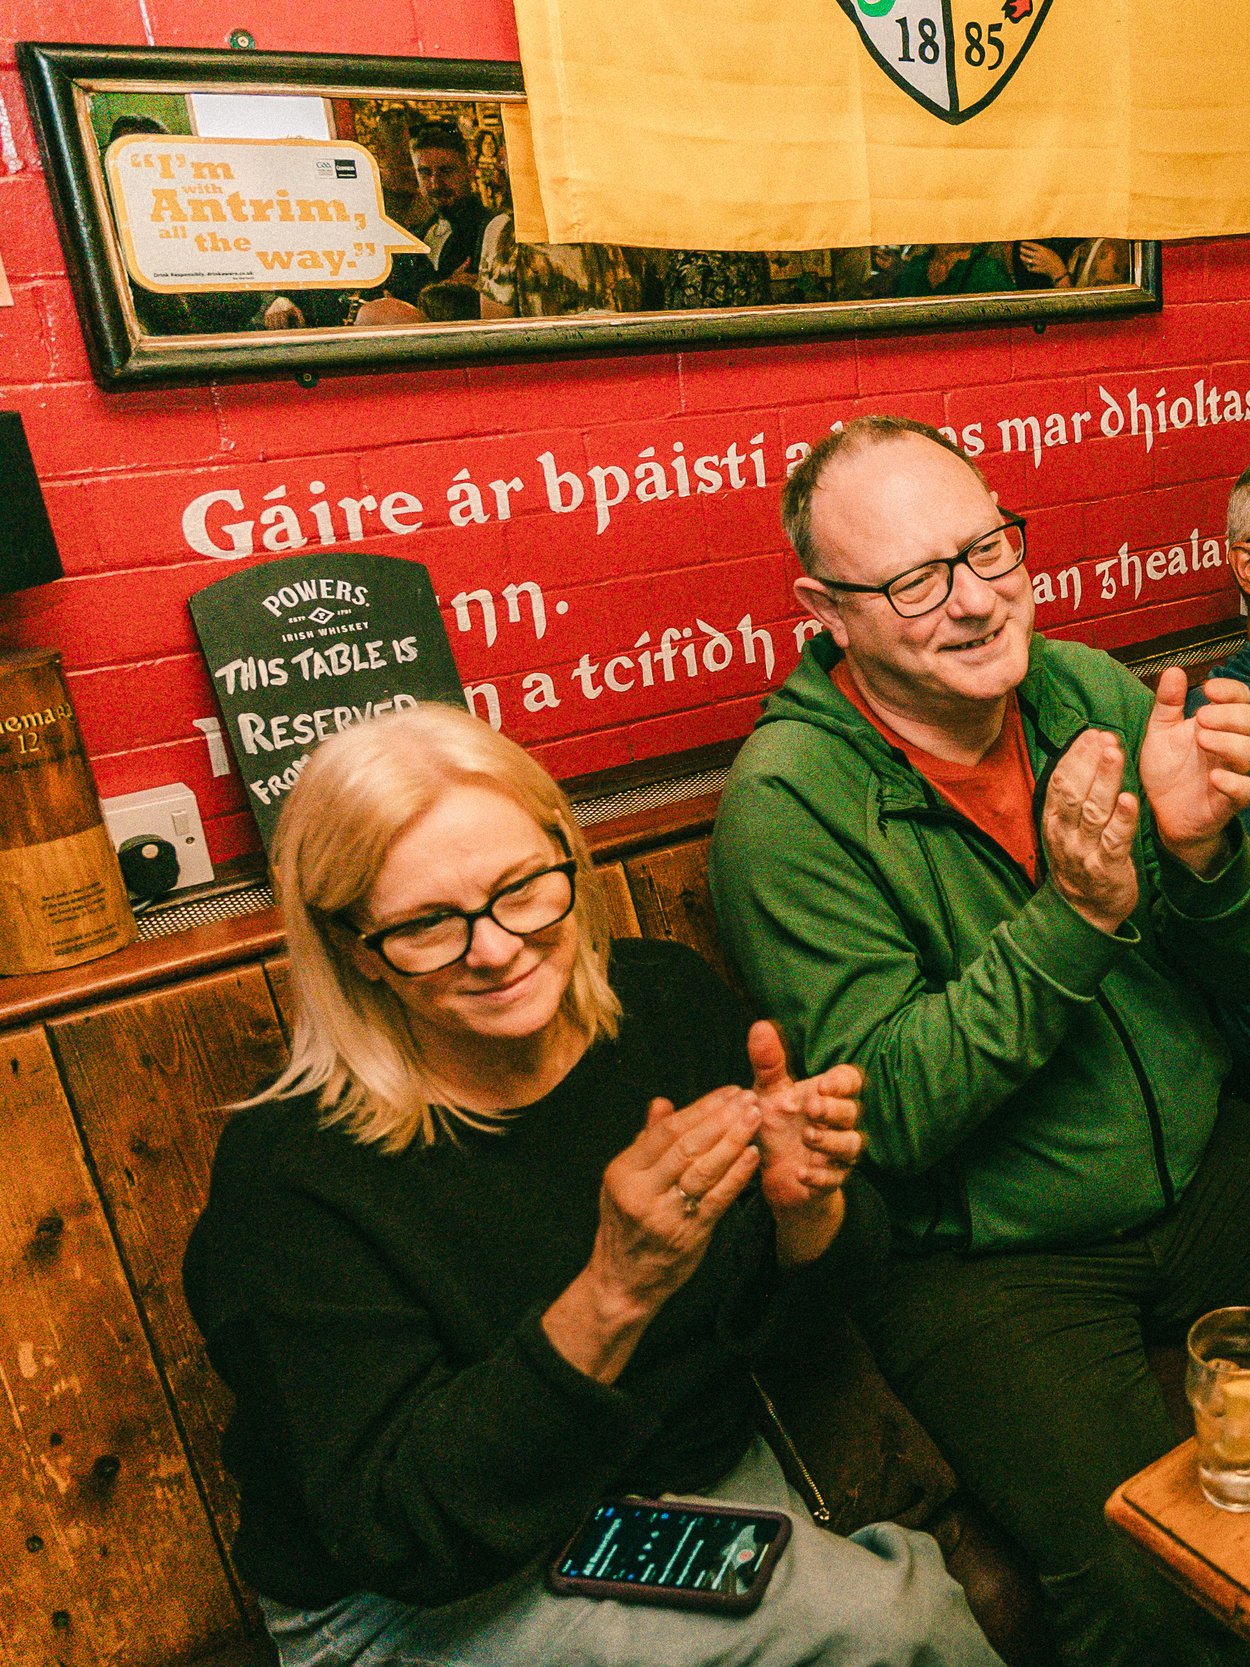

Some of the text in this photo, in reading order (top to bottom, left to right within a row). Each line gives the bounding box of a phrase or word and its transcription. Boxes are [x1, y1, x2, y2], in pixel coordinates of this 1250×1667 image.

[895, 17, 1004, 70] 18 85
[182, 183, 224, 194] with
[150, 188, 367, 231] Antrim,
[158, 225, 188, 239] all
[194, 231, 251, 252] the
[182, 480, 424, 560] Gáire
[448, 468, 524, 528] ár
[536, 432, 767, 535] bpáistí
[998, 411, 1091, 469] mar
[281, 621, 370, 643] IRISH WHISKEY
[523, 672, 562, 713] a
[1032, 567, 1082, 611] an
[215, 636, 419, 695] THIS TABLE IS
[18, 731, 39, 754] 12
